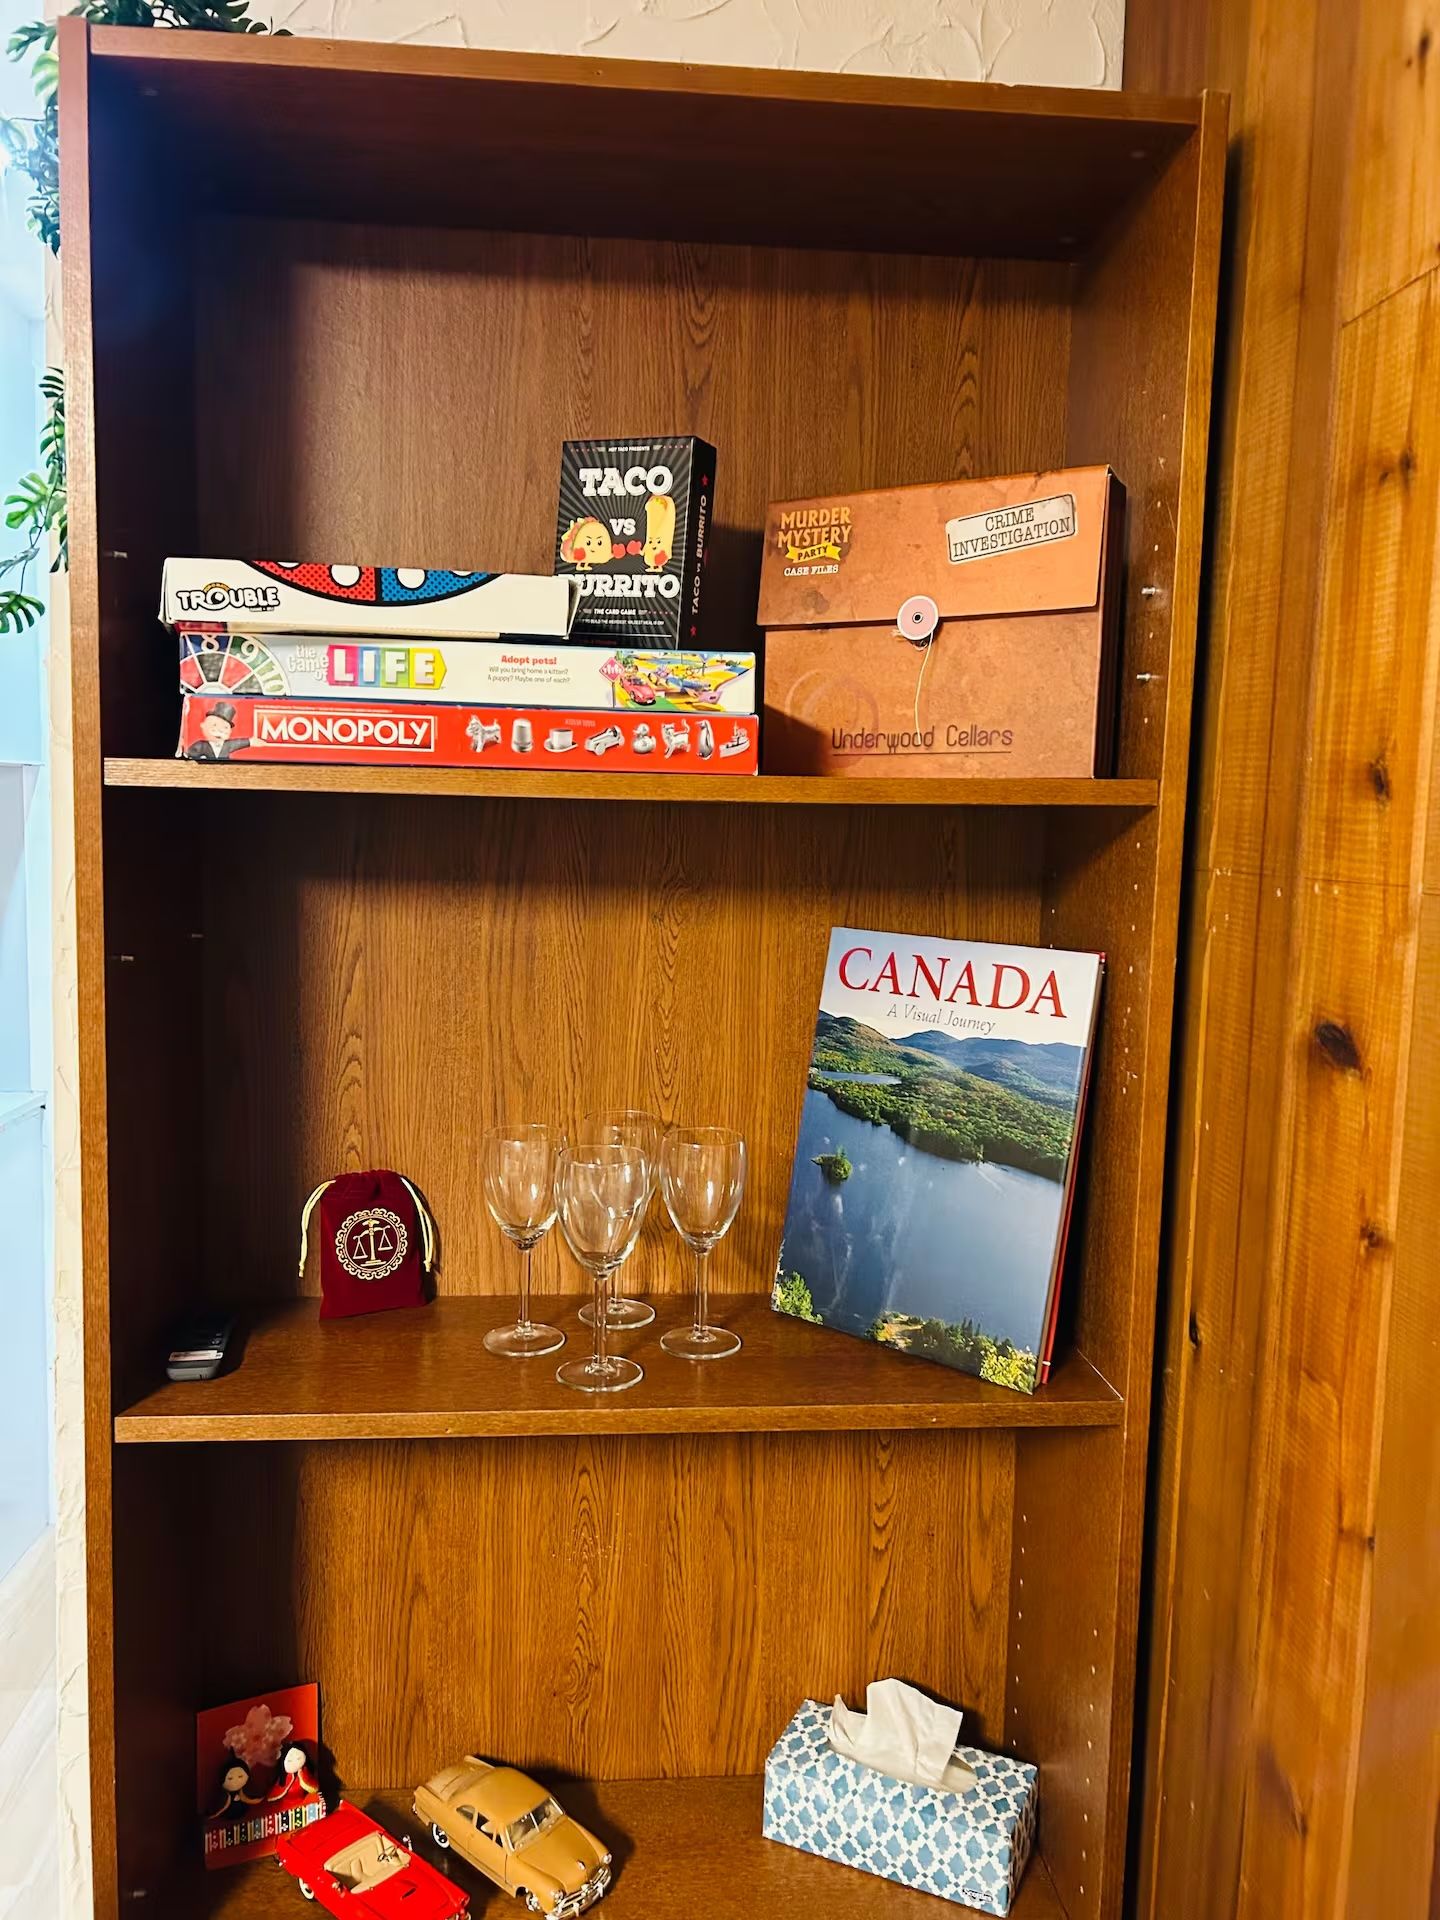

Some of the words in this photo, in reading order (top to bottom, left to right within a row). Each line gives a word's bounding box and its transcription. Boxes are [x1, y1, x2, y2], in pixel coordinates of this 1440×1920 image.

[579, 465, 673, 497] TACO
[609, 518, 636, 536] VS
[695, 494, 707, 559] BURRITO
[781, 506, 852, 530] MURDER
[985, 507, 1035, 532] CRIME
[777, 525, 852, 548] MYSTERY
[953, 516, 1071, 557] INVESTIGATION
[797, 545, 828, 560] PARTY
[784, 566, 809, 576] CASE
[810, 564, 839, 575] FILES
[558, 573, 681, 599] URRITO
[691, 576, 701, 615] TACO
[176, 586, 281, 612] TROUBLE
[619, 608, 636, 616] GAME
[295, 645, 317, 659] the
[501, 655, 530, 666] Adopt
[532, 656, 557, 666] pets!
[332, 648, 436, 685] LIFE
[492, 675, 514, 683] puppy?
[514, 675, 533, 683] Maybe
[511, 667, 526, 675] bring
[261, 715, 430, 746] MONOPOLY
[832, 725, 935, 754] Underwood
[946, 724, 1013, 747] Cellars
[838, 947, 1068, 1018] CANADA
[887, 1003, 898, 1018] A
[904, 1004, 943, 1024] Visual
[946, 1010, 997, 1034] Journey
